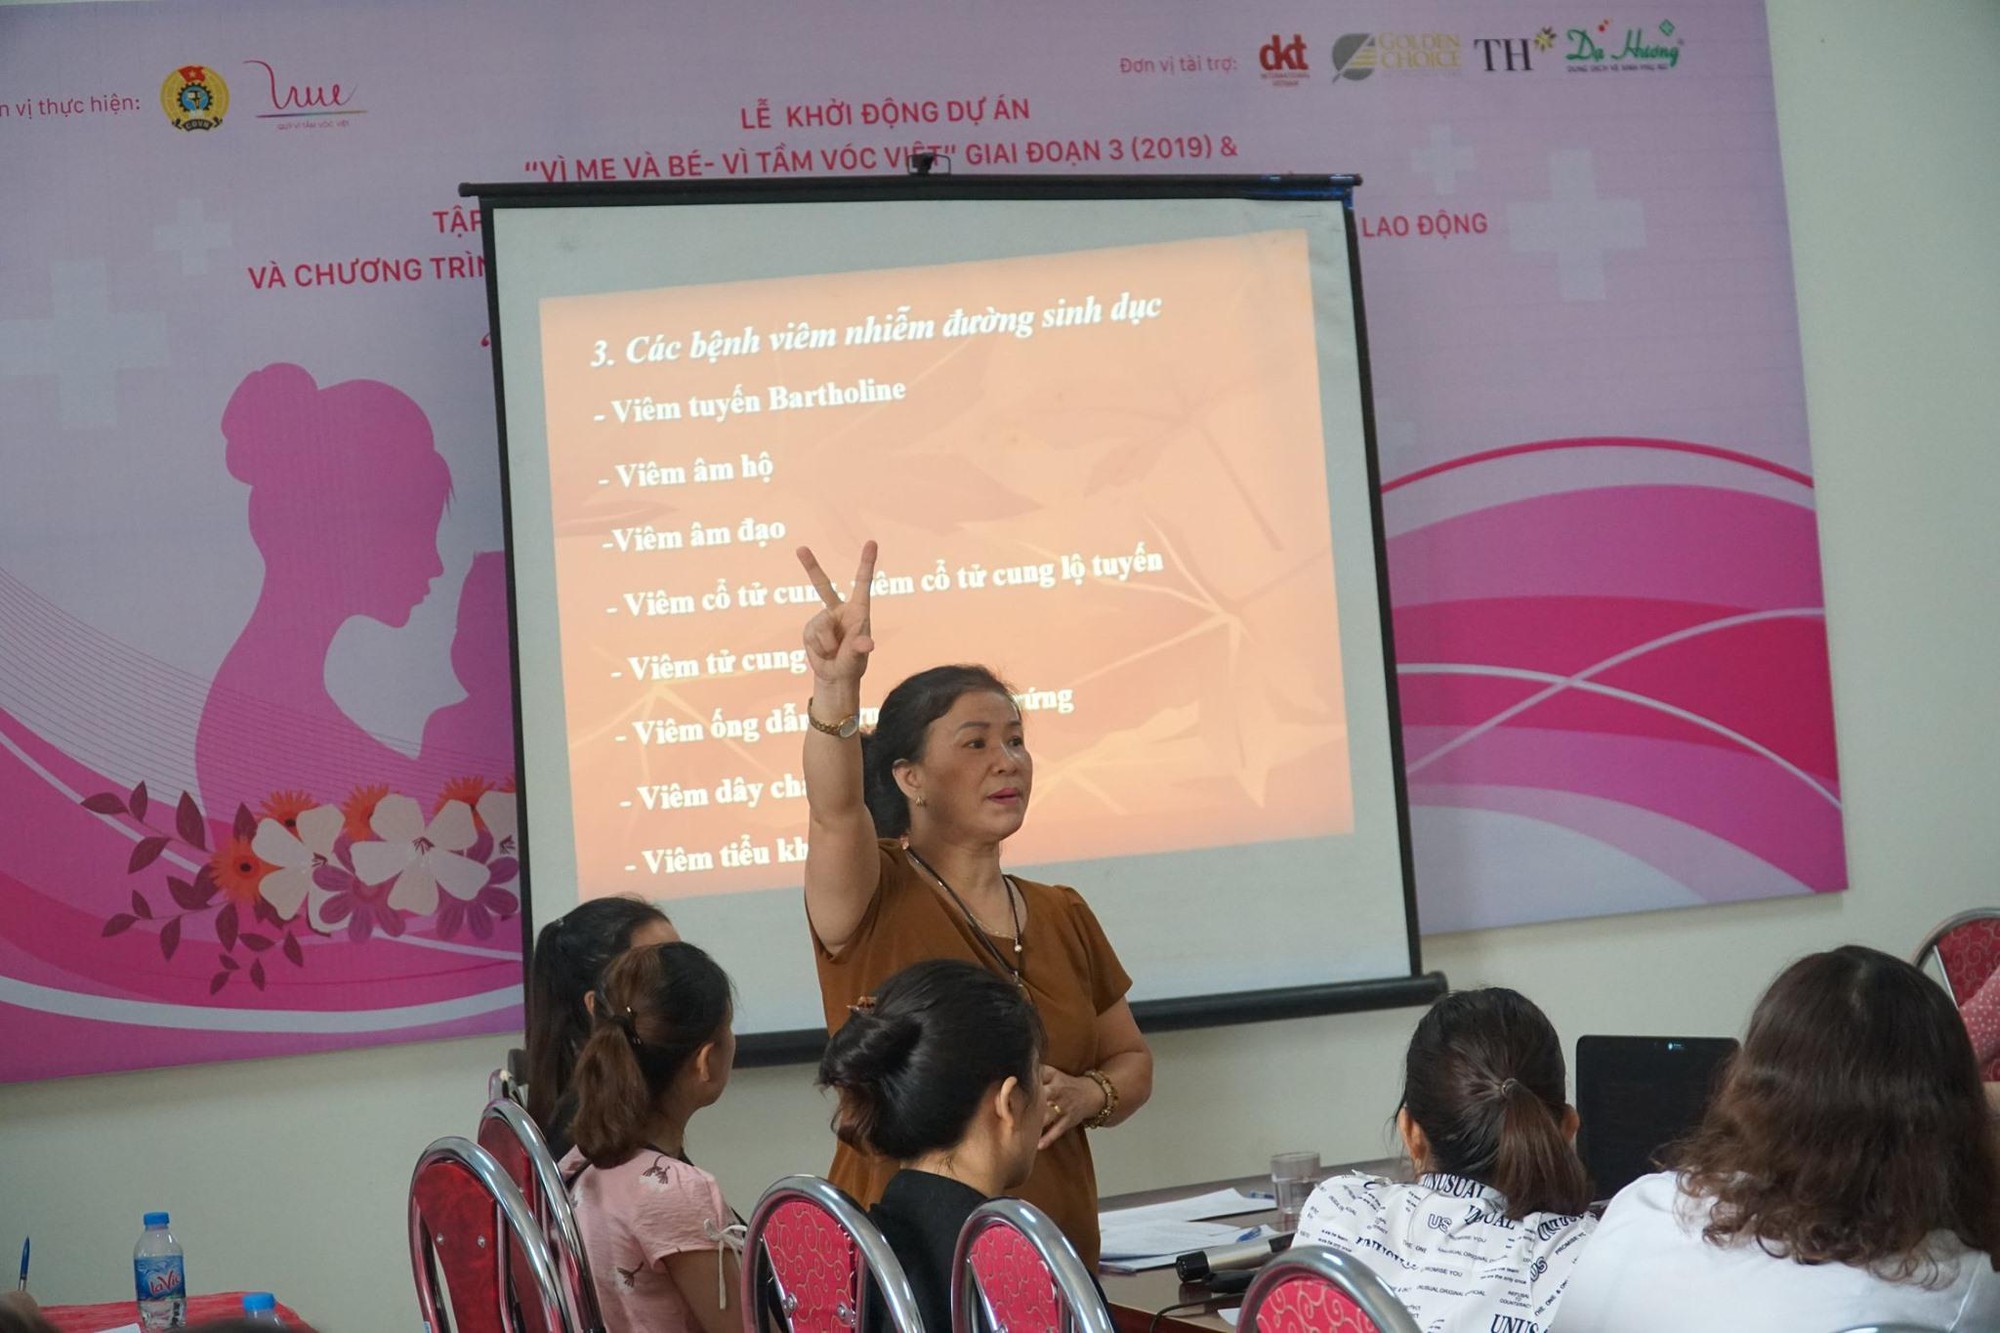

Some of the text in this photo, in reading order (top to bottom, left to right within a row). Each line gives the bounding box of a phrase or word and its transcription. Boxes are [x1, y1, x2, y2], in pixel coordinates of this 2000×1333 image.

[1120, 57, 1155, 73] Đơn
[1160, 56, 1175, 75] vị
[1180, 55, 1201, 72] tài
[1473, 38, 1533, 72] TH
[16, 98, 32, 119] vị
[38, 98, 84, 118] thực
[90, 93, 140, 115] hiện:
[741, 98, 771, 129] LỄ
[861, 97, 939, 129] ĐỘNG
[948, 96, 986, 126] DỰ
[993, 93, 1031, 120] ÁN
[624, 151, 661, 178] VÀ
[722, 147, 748, 175] VÌ
[756, 142, 813, 173] TẦM
[821, 143, 877, 170] VÓC
[965, 142, 1018, 167] GIAI
[1026, 140, 1100, 168] ĐOẠN
[1108, 138, 1124, 161] 3
[1131, 133, 1213, 162] (2019)
[1221, 136, 1238, 157] &
[1362, 215, 1409, 237] LAO
[1417, 209, 1488, 240] ĐỘNG
[248, 260, 286, 289] VÀ
[294, 258, 422, 287] CHƯƠNG
[590, 292, 1162, 367] 3. Các bệnh viêm nhiễm đường sinh dục
[611, 397, 681, 423] Viêm
[689, 384, 761, 422] tuyến
[768, 378, 906, 411] Bartholine
[615, 461, 686, 488] Viêm
[694, 457, 734, 483] âm
[741, 451, 774, 483] hộ
[690, 521, 731, 547] âm
[737, 517, 785, 548] đạo
[624, 589, 695, 617] Viêm
[702, 578, 731, 611] cổ
[738, 582, 768, 608] tử
[921, 559, 950, 592] cổ
[957, 564, 988, 589] tử
[992, 562, 1056, 588] cung
[1061, 553, 1086, 586] lộ
[1091, 541, 1163, 581] tuyến
[627, 653, 699, 681] Viêm
[706, 649, 736, 674] tử
[742, 649, 808, 674] cung
[632, 718, 704, 745] Viêm
[710, 708, 760, 742] ống
[637, 783, 709, 810] Viêm
[715, 776, 764, 808] dây
[642, 847, 714, 874] Viêm
[720, 834, 770, 867] tiểu
